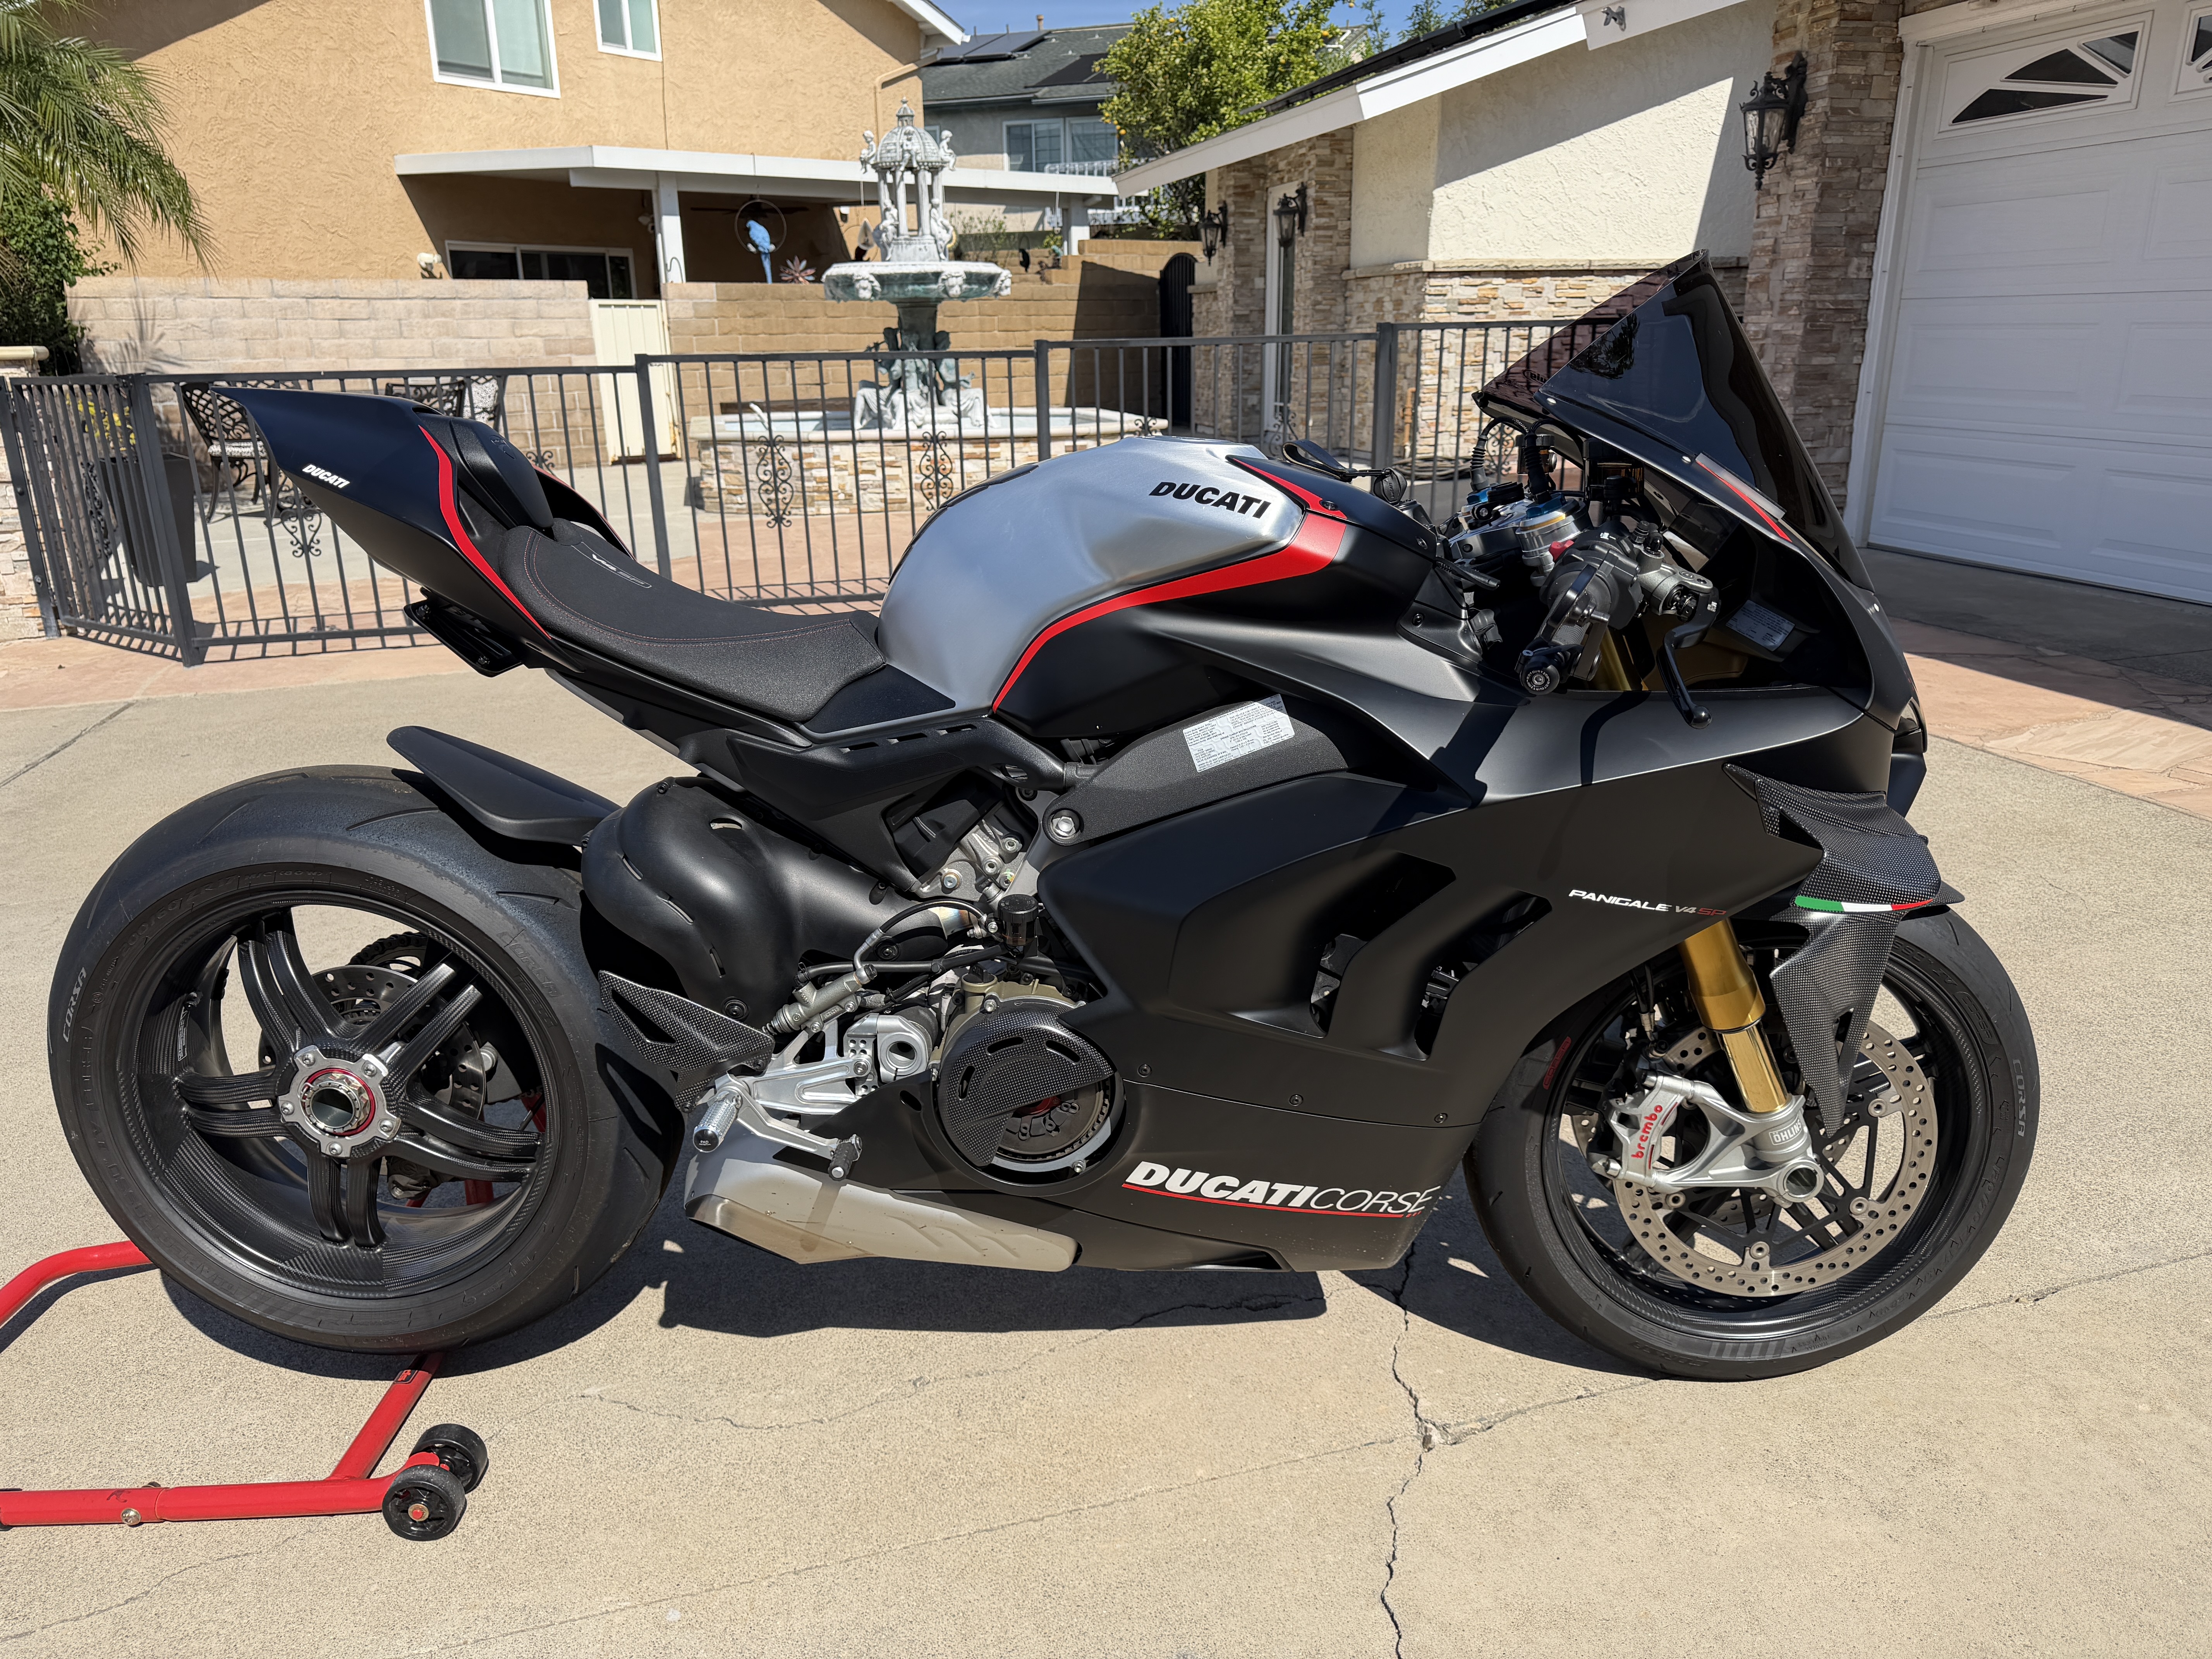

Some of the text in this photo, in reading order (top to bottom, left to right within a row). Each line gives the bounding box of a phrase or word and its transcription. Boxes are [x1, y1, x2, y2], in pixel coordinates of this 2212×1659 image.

[302, 464, 350, 488] DUCATI
[1149, 482, 1272, 519] DUCATI
[1568, 889, 1672, 912] PANIGALE
[63, 967, 87, 1042] CORSA
[2013, 1059, 2026, 1137] CORSA
[1631, 1104, 1663, 1160] brembo
[1773, 1119, 1802, 1144] ÖHLINS
